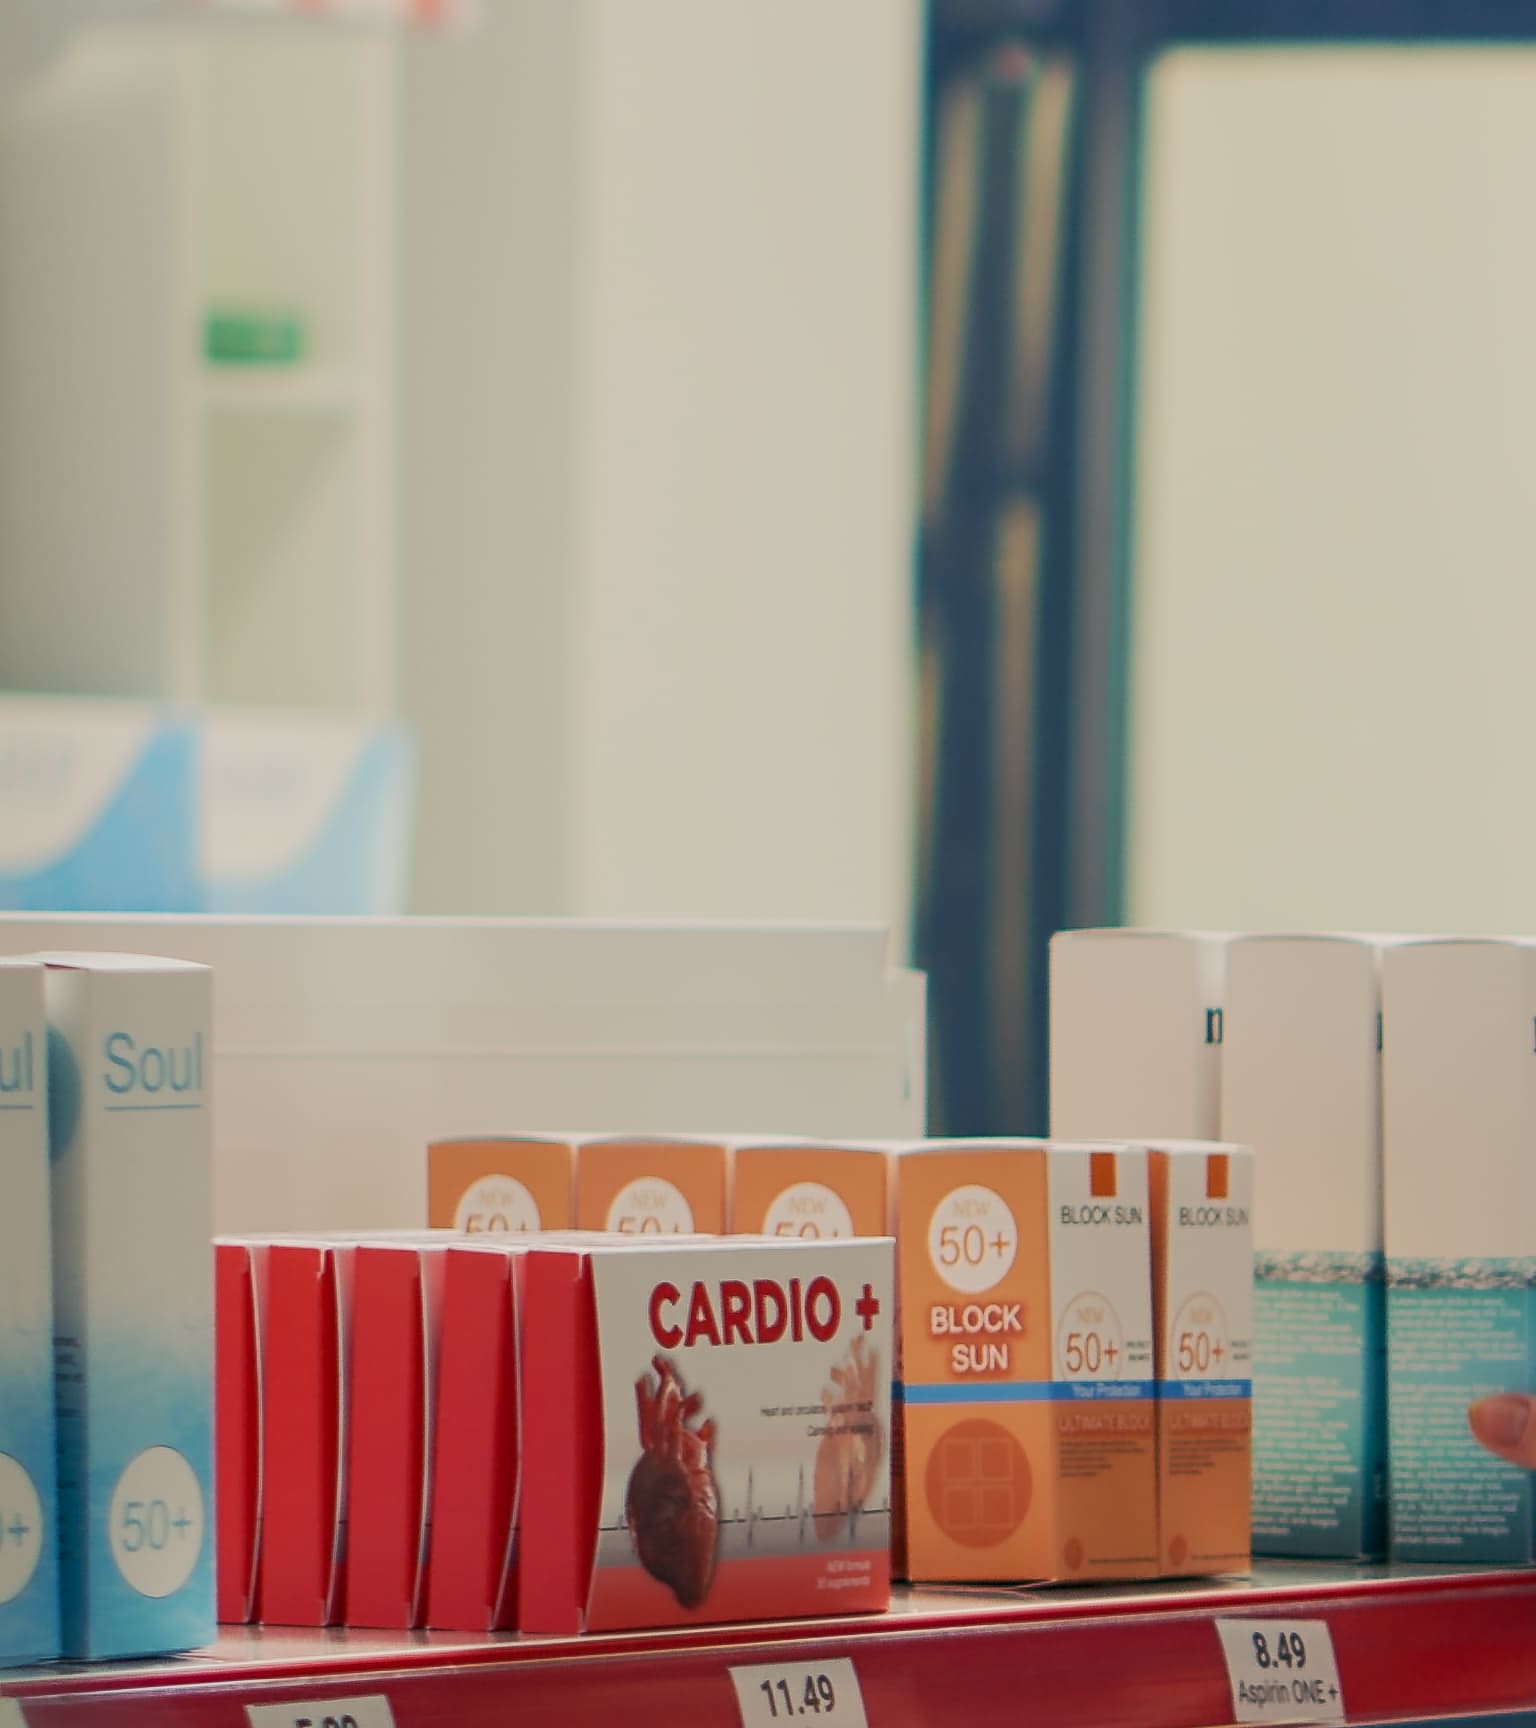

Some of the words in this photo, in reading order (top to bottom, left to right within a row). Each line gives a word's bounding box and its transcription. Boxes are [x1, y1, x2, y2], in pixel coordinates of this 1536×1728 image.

[104, 1031, 203, 1093] Soul
[952, 1200, 990, 1217] NEW
[1061, 1206, 1112, 1225] BLOCK
[1115, 1207, 1143, 1225] SUN
[1179, 1207, 1221, 1226] BLOCK
[1226, 1208, 1249, 1226] SUN
[939, 1225, 1011, 1266] 50+
[649, 1277, 841, 1349] CARDIO
[930, 1304, 1022, 1335] BLOCK
[952, 1343, 1009, 1372] SUN
[1066, 1331, 1118, 1373] 50+
[1178, 1331, 1224, 1372] 50+
[122, 1500, 192, 1551] 50+
[1252, 1631, 1306, 1668] 8.49
[760, 1674, 835, 1717] 11.49
[1239, 1680, 1290, 1709] Aspirin
[1292, 1680, 1327, 1704] ONE
